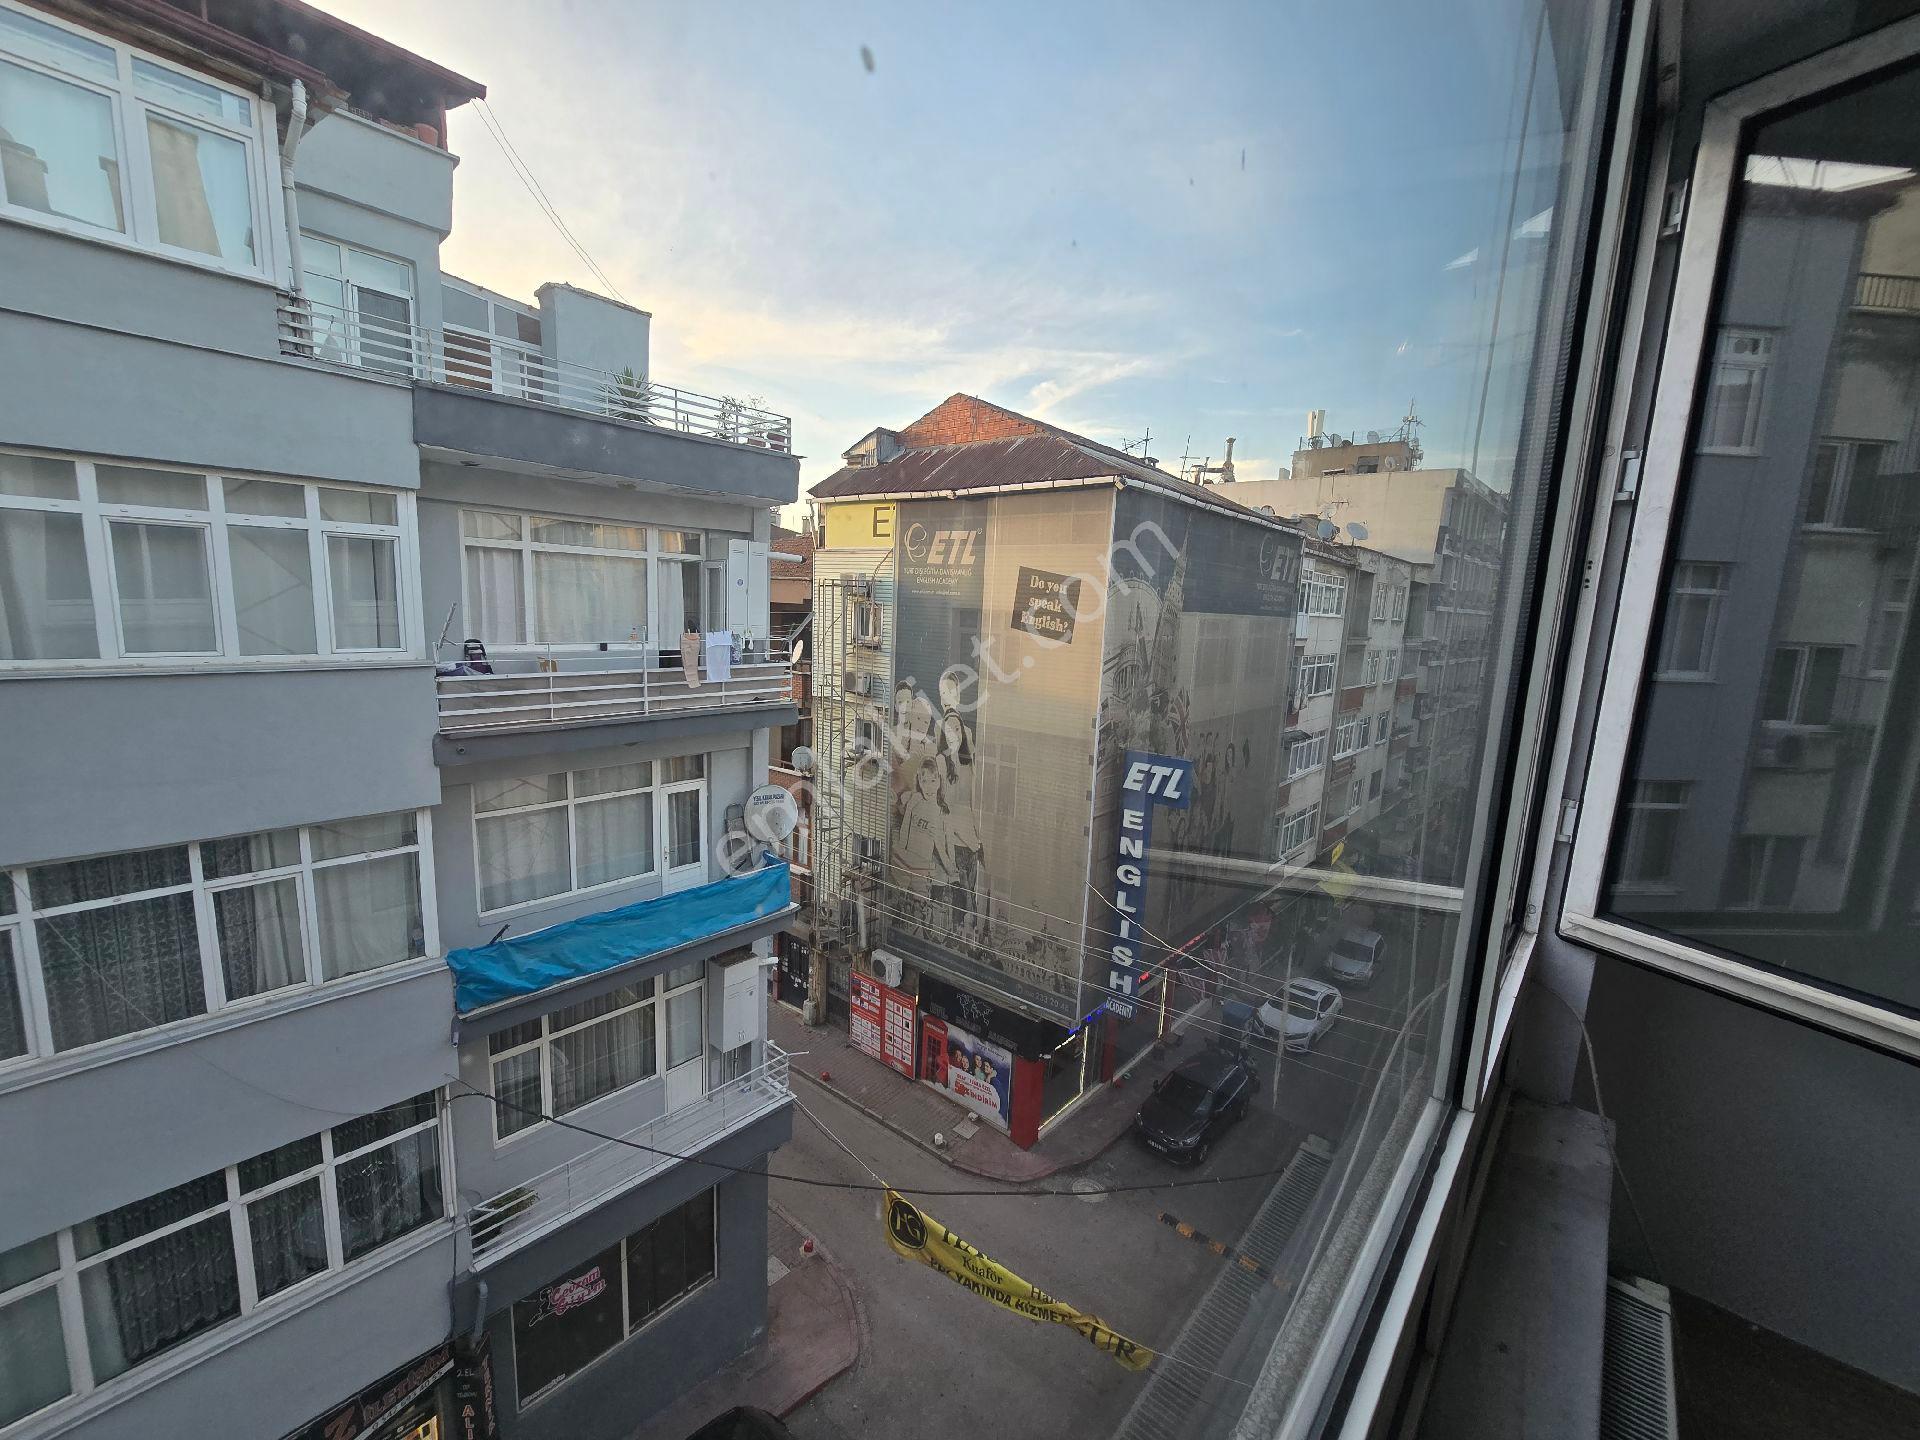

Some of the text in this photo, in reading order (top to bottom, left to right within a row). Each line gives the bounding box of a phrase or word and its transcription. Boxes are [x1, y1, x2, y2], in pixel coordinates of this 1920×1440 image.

[873, 506, 891, 537] E
[927, 530, 978, 565] ETL
[1030, 575, 1068, 595] Do you
[1028, 597, 1062, 613] speak
[1020, 610, 1069, 633] English?
[1123, 762, 1183, 800] ETL
[1109, 809, 1145, 995] ENGLISH
[963, 1256, 1003, 1285] Kuaför
[956, 1272, 1012, 1307] YAKINDA
